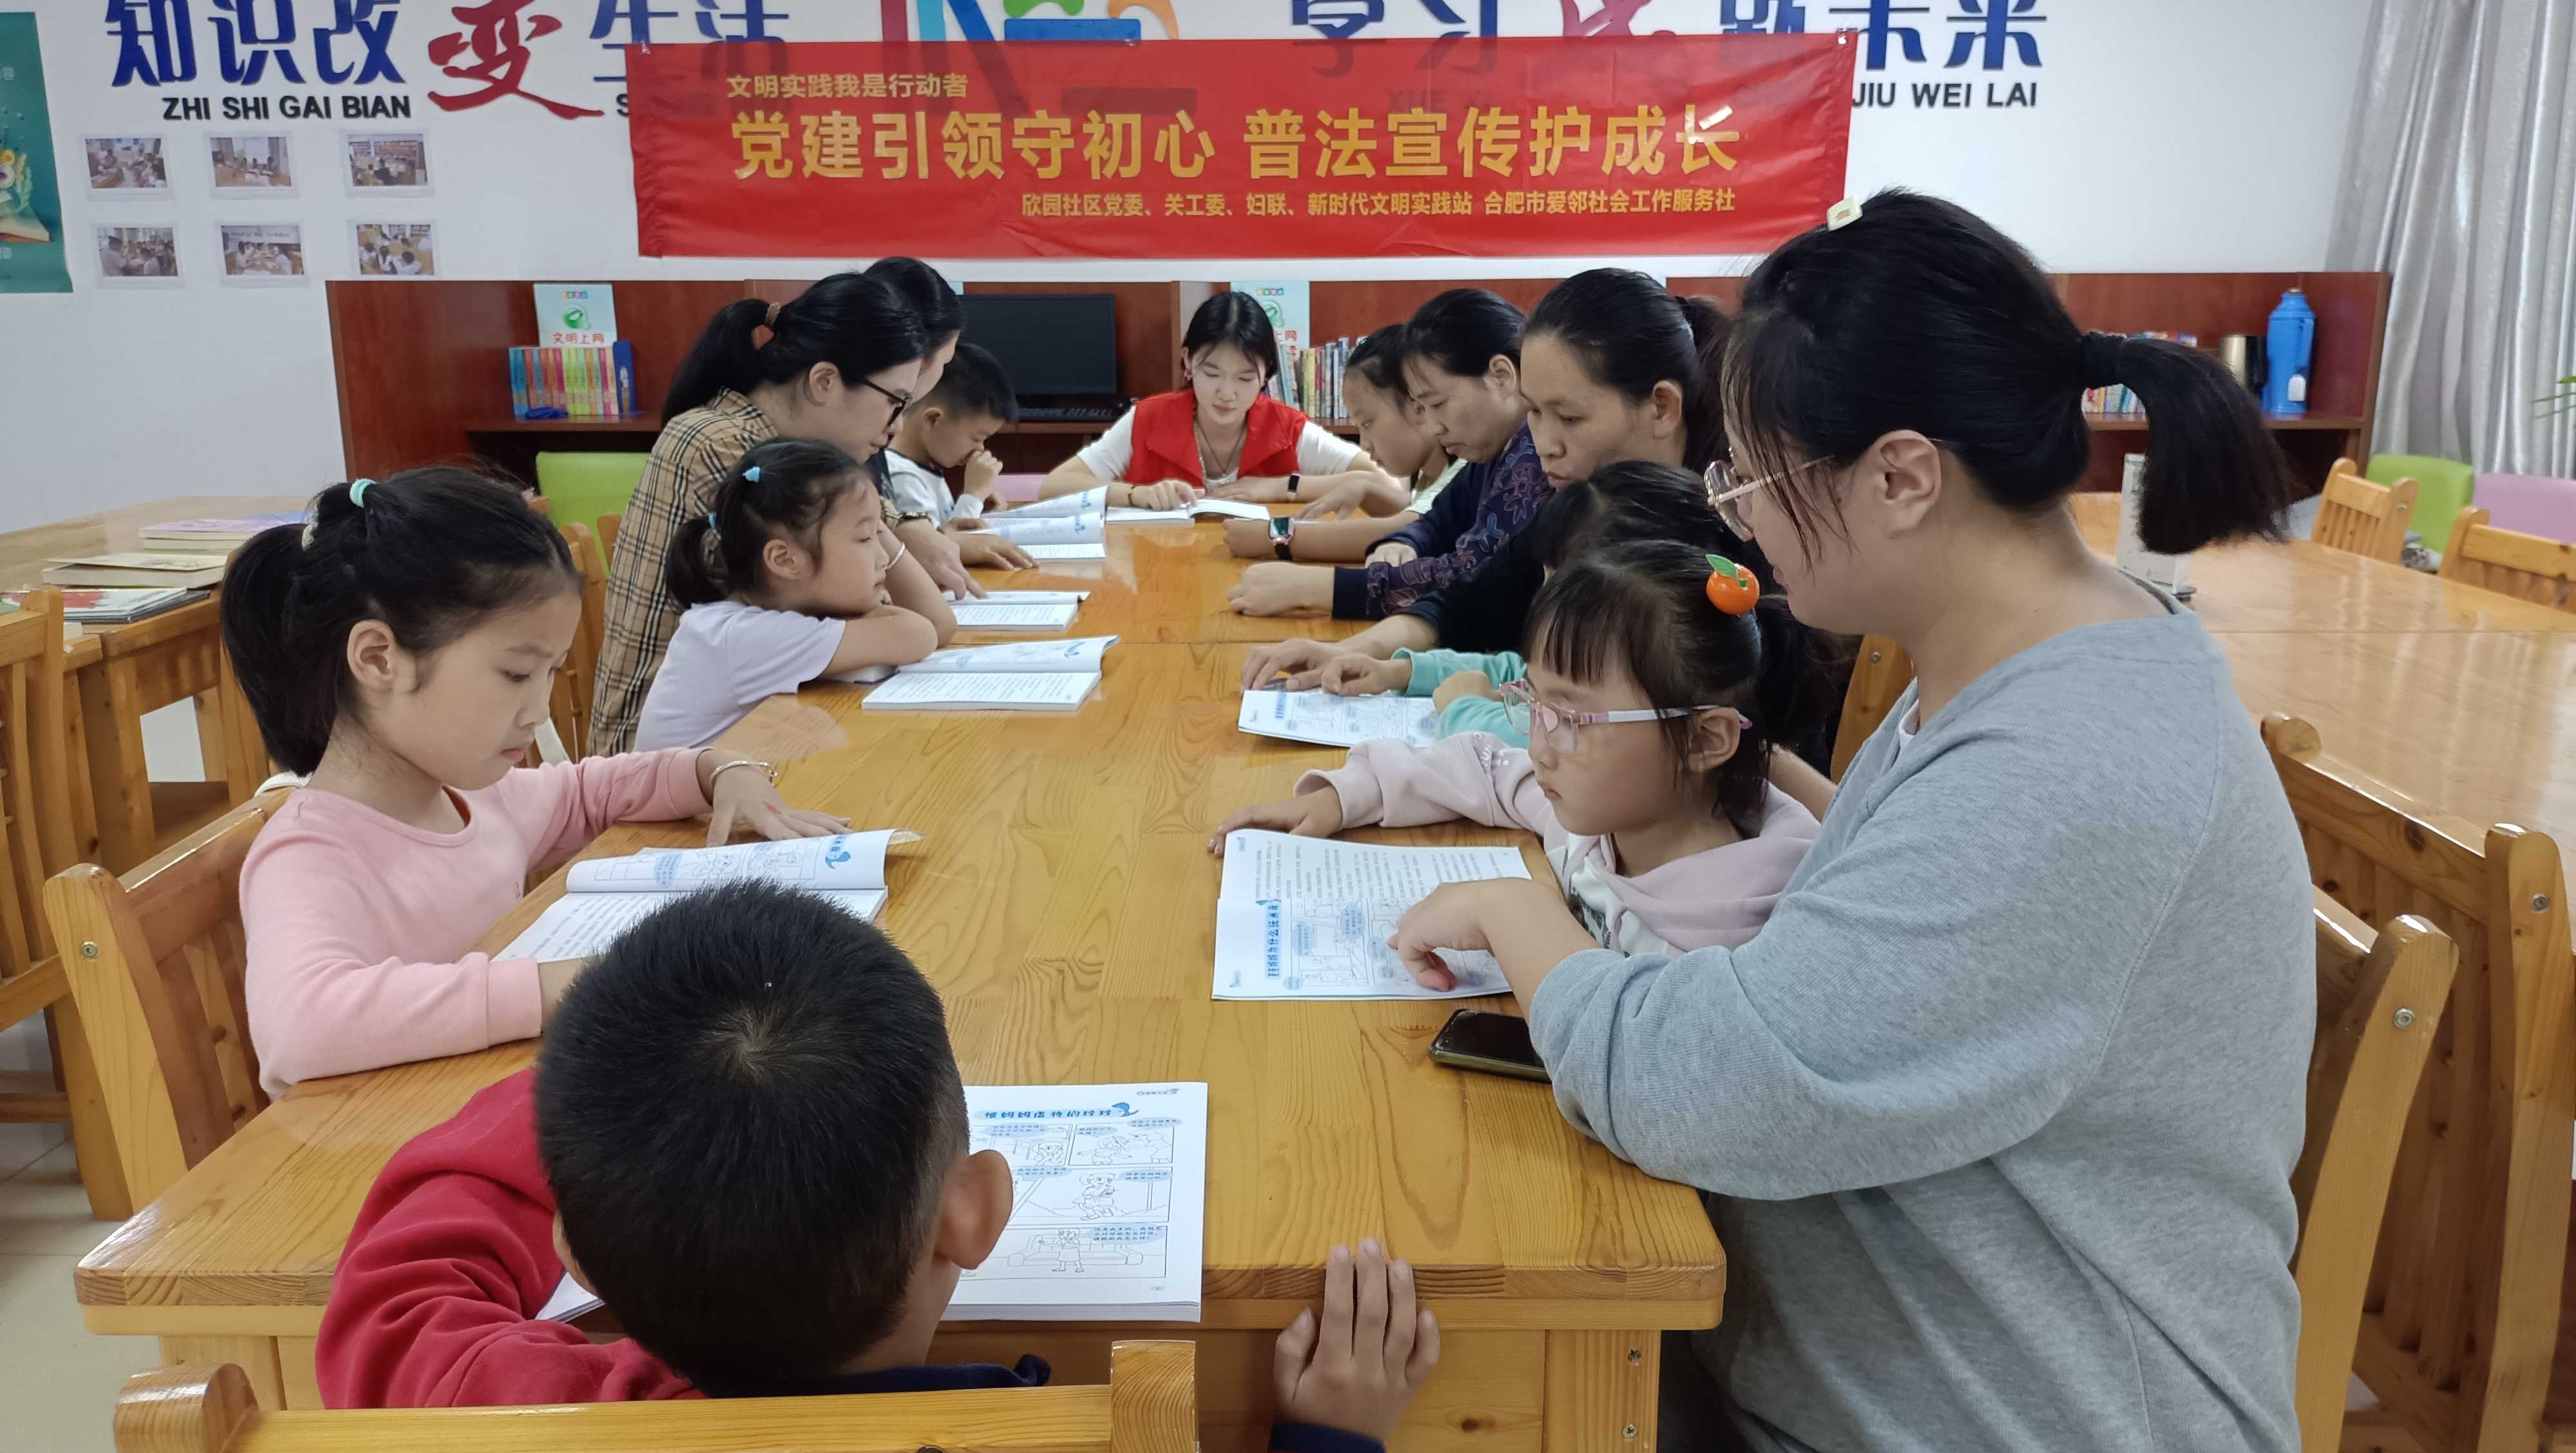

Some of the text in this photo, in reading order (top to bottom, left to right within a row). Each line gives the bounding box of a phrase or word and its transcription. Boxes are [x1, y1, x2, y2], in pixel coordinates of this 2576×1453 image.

[726, 73, 969, 99] 文明实践我是行动者
[1912, 83, 1972, 107] WEI
[1987, 82, 2037, 107] LAI
[162, 95, 412, 121] ZHI SHI GAI BIAN
[732, 103, 1740, 180] 党建引领守初心 普法宣传护成长
[1021, 188, 1736, 217] 欣园社区党委、关工委、妇联、新时代文明实践站 合肥市爱邻社会工作服务社
